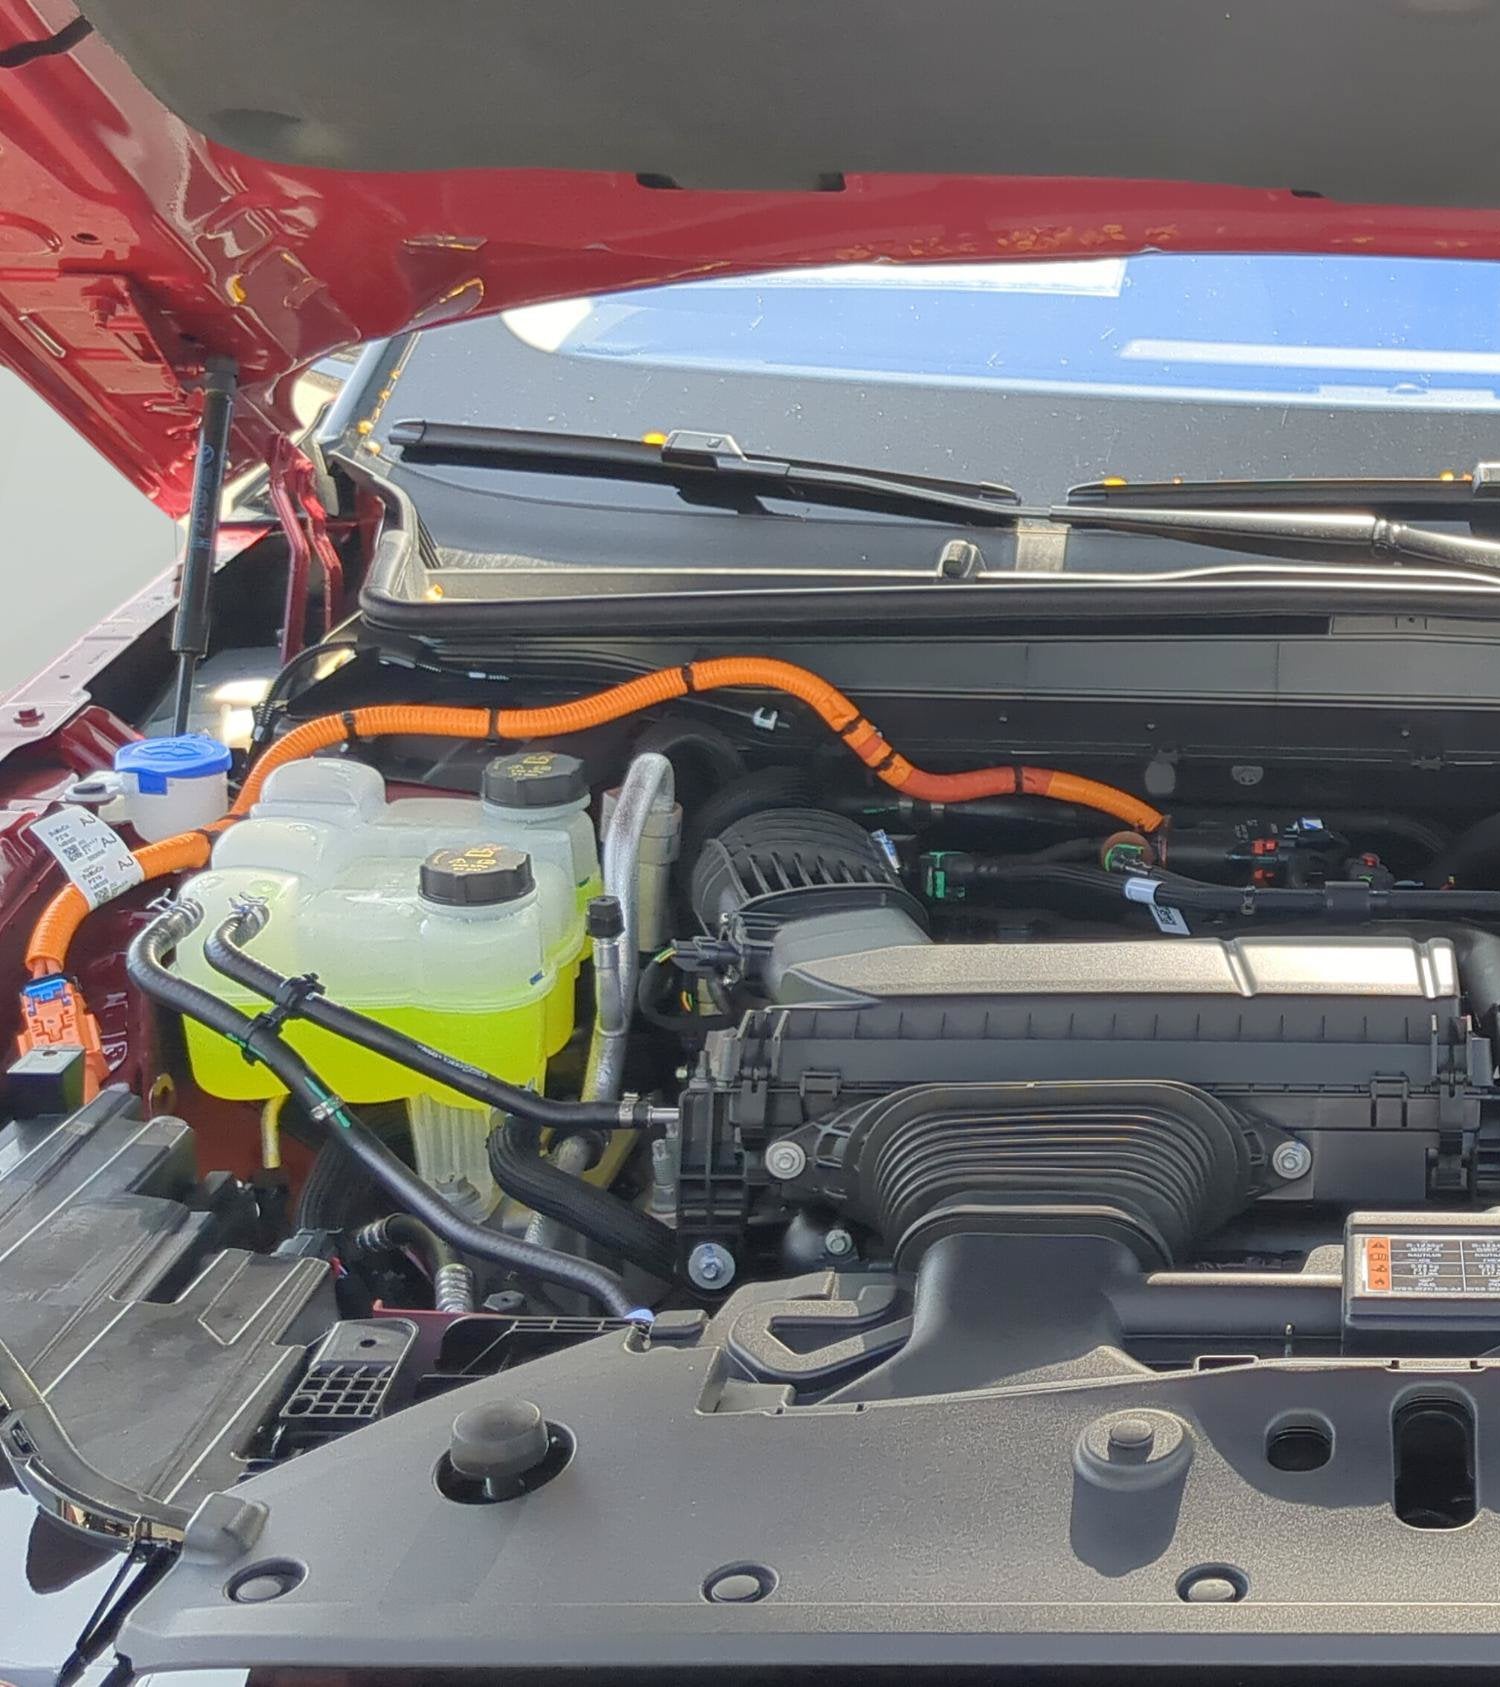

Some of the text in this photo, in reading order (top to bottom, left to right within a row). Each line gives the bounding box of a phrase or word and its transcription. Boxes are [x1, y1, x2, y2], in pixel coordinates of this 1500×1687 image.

[79, 814, 97, 827] AJ
[101, 832, 118, 848] AJ
[117, 855, 134, 872] AJ
